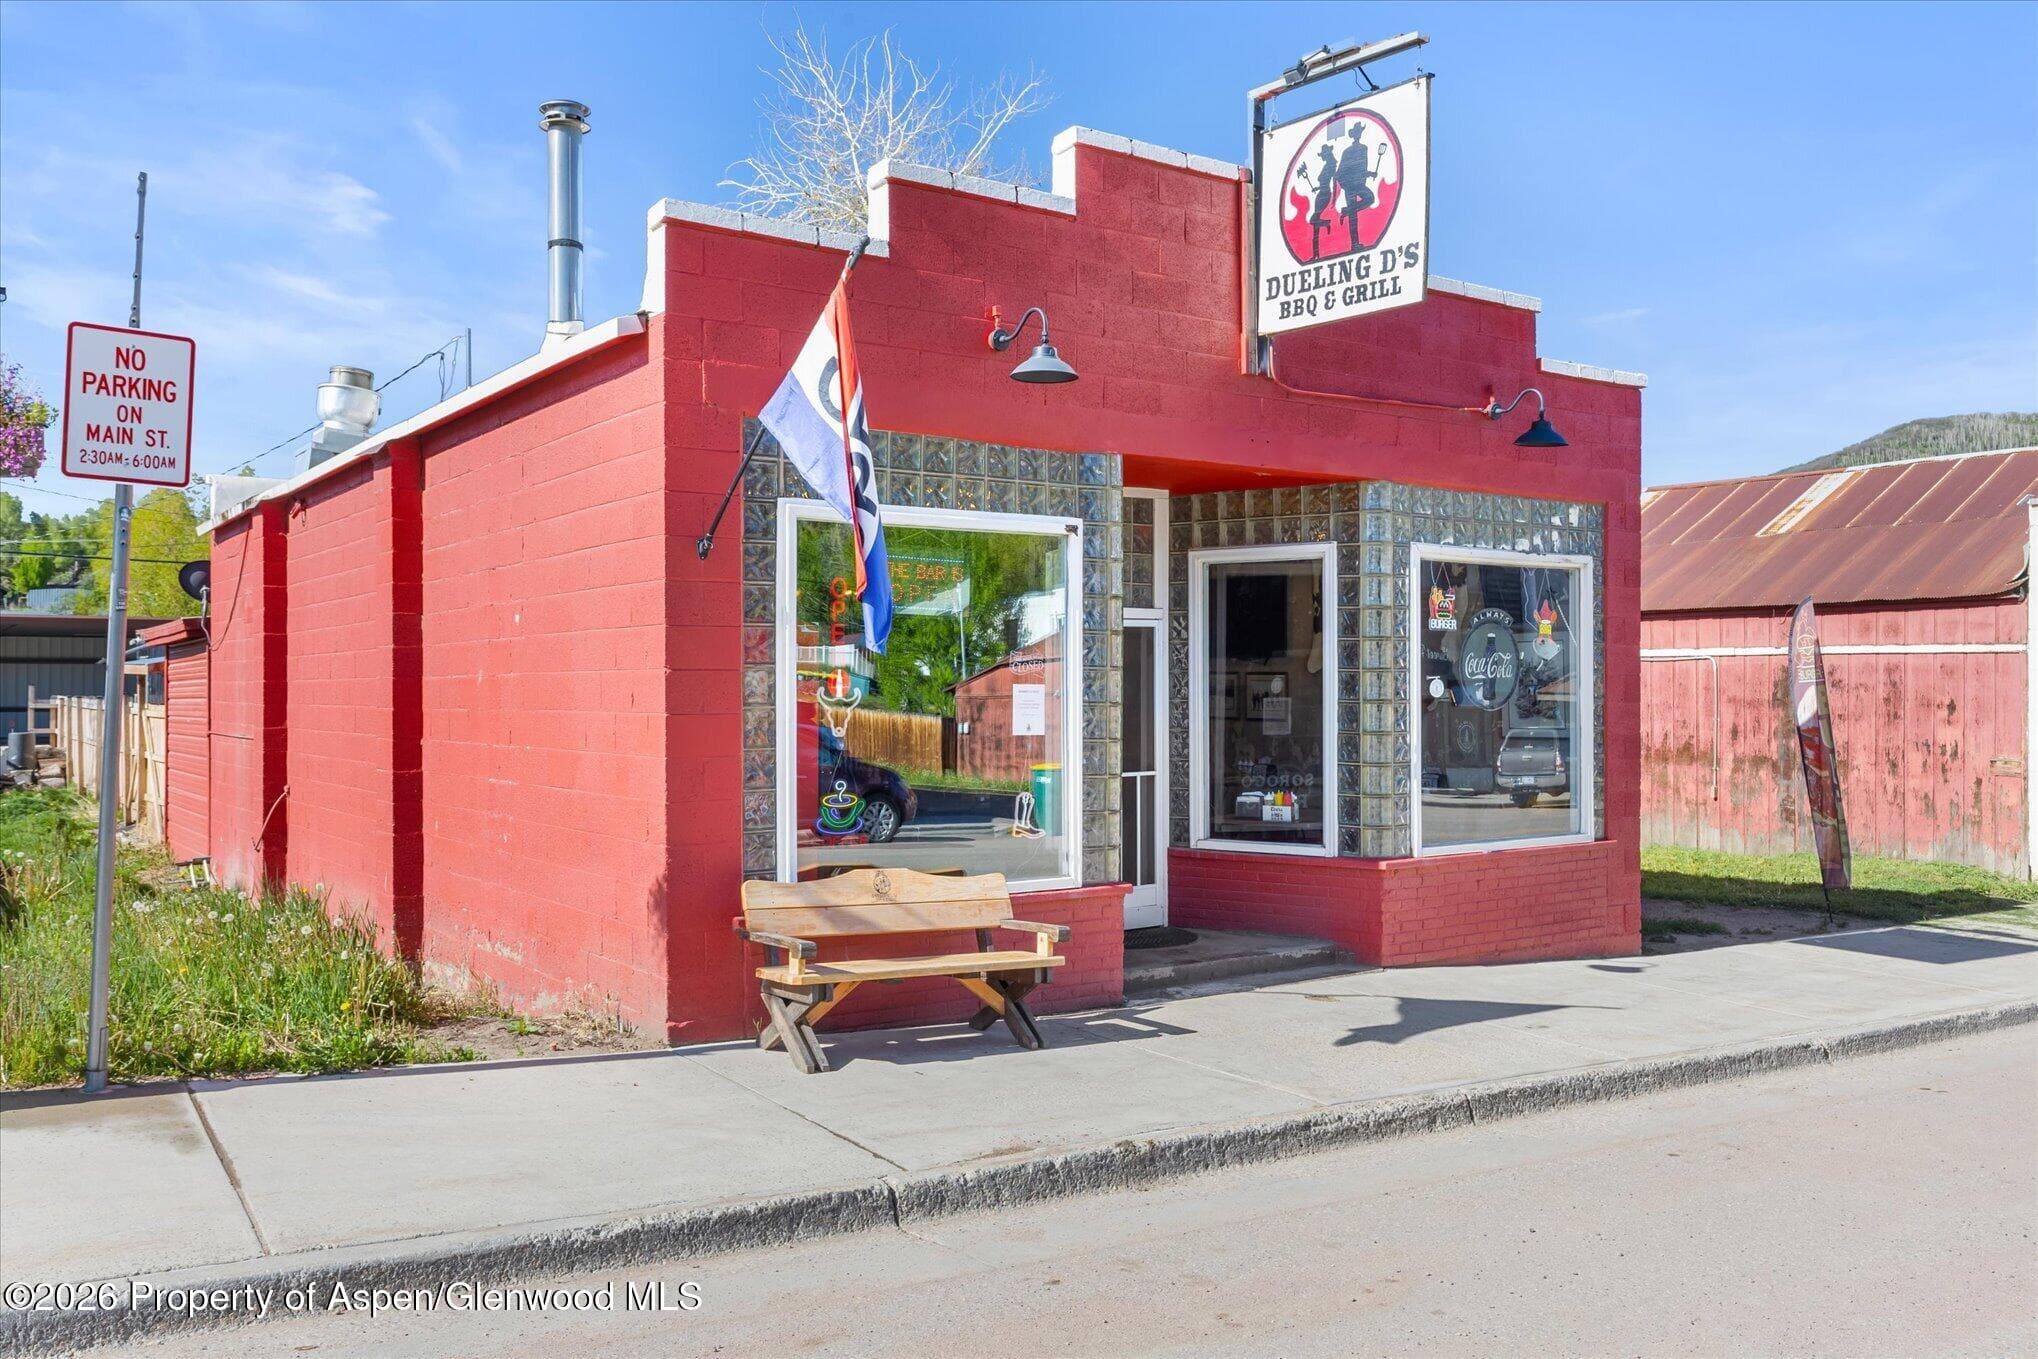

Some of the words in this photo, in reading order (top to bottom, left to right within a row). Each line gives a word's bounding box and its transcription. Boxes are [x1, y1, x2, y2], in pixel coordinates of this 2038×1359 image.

[1266, 254, 1371, 301] DUELING
[1379, 242, 1419, 275] D'S
[1279, 294, 1317, 320] BBQ
[1324, 290, 1336, 310] &
[1342, 276, 1401, 306] GRILL
[115, 346, 146, 371] NO
[82, 371, 177, 403] PARKING
[117, 404, 142, 424] ON
[86, 423, 133, 445] MAIN
[145, 429, 170, 449] ST.
[917, 563, 945, 581] BAR
[829, 575, 848, 660] OPE
[1430, 618, 1457, 630] BURGER
[1473, 610, 1510, 624] ALWAYS
[1012, 660, 1044, 673] CLOSED
